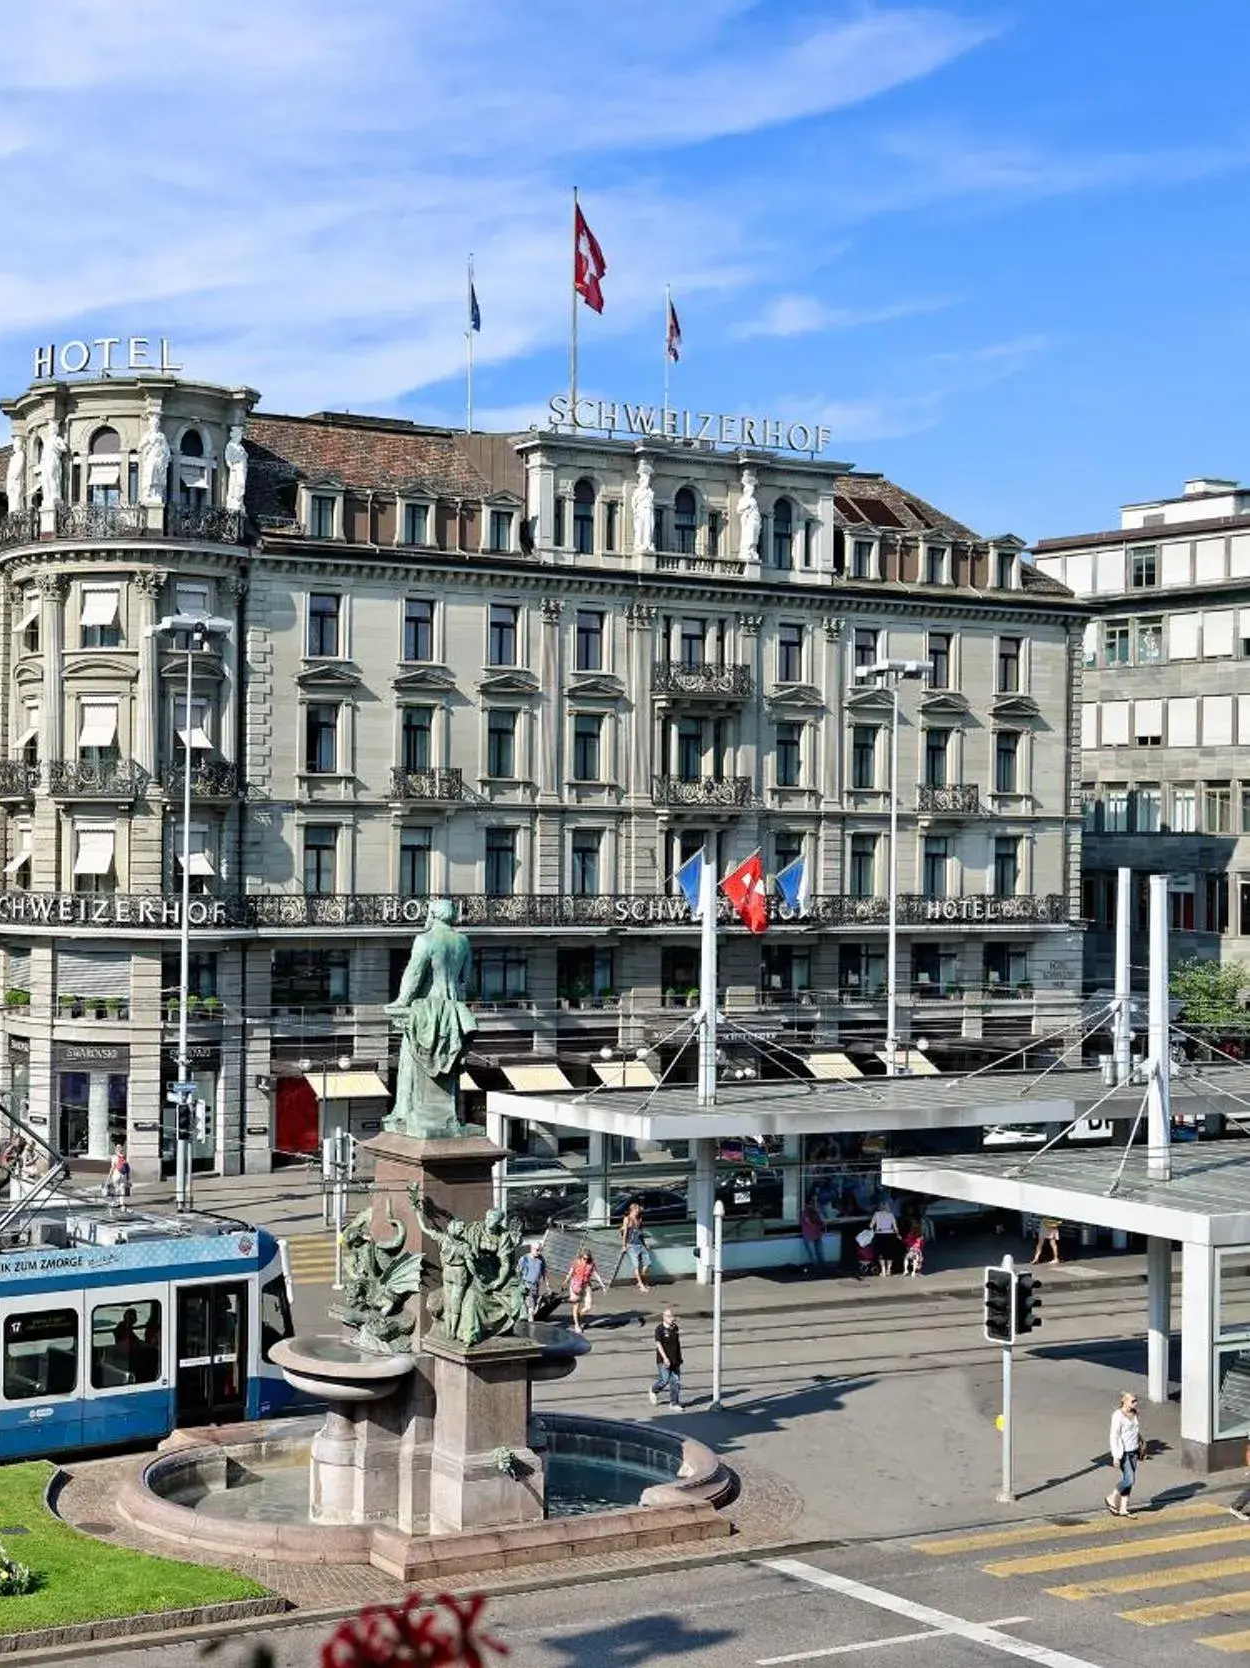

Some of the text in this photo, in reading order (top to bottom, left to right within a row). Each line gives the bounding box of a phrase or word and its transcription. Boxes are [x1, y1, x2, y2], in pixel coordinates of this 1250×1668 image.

[34, 336, 184, 379] HOTEL
[550, 395, 831, 453] SCHWEIZERHOF
[382, 900, 465, 923] HOL
[926, 900, 999, 920] HOTEL
[14, 1259, 39, 1273] ZUM
[41, 1255, 83, 1270] ZMORGE
[11, 1321, 22, 1333] 17
